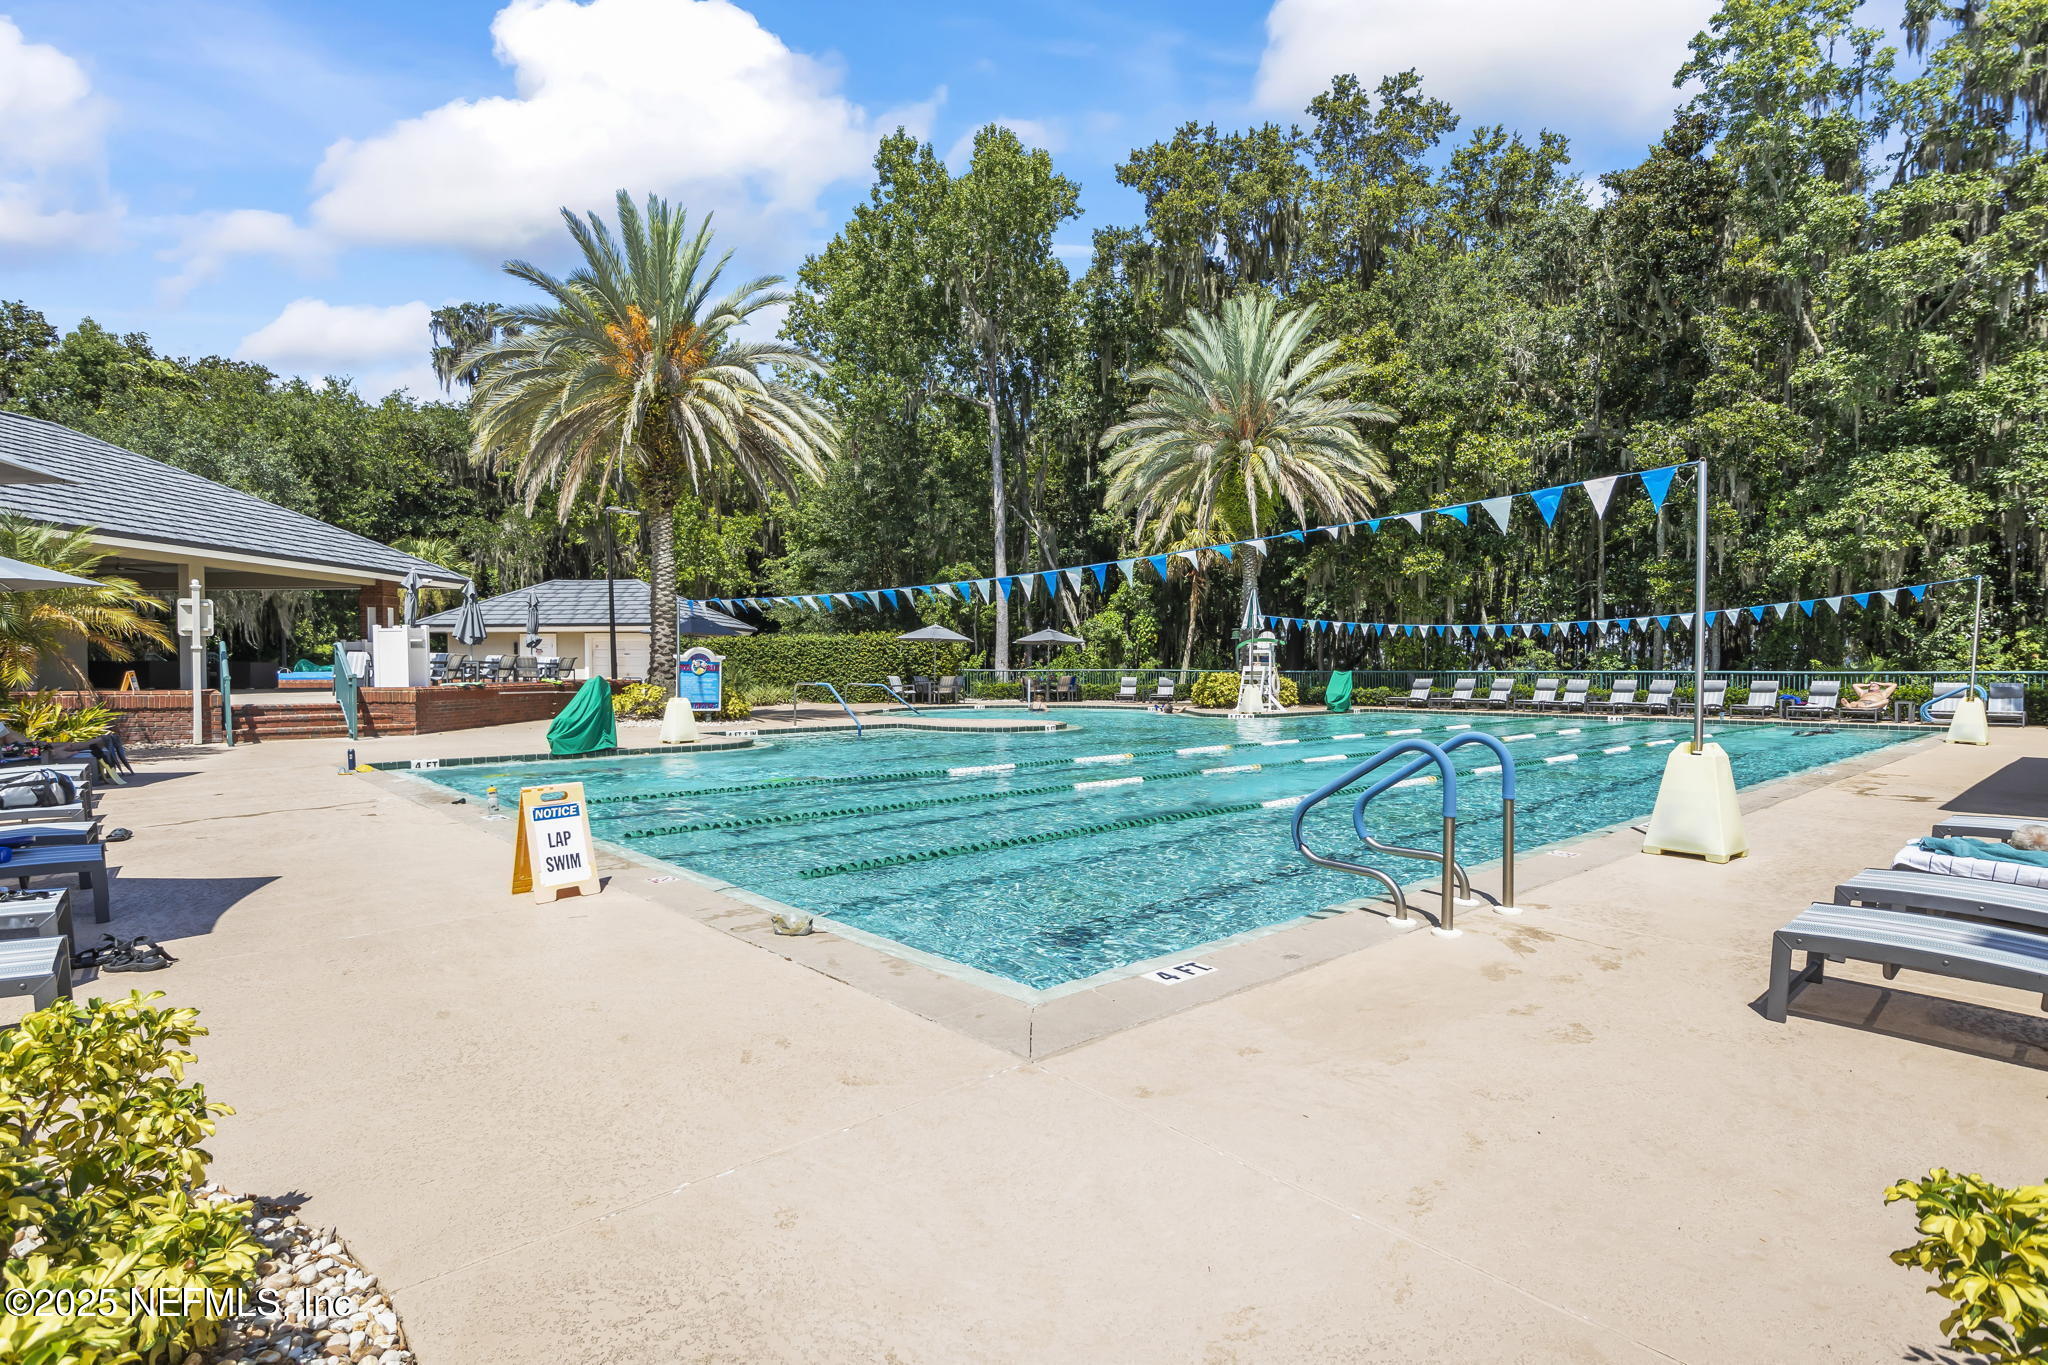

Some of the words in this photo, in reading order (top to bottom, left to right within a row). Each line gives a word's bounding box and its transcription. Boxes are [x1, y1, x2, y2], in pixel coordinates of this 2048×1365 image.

[415, 761, 421, 769] 4
[534, 804, 579, 820] NOTICE
[547, 830, 572, 848] LAP
[545, 852, 582, 873] SWIM
[1156, 971, 1181, 980] 4
[1173, 962, 1213, 975] FT
